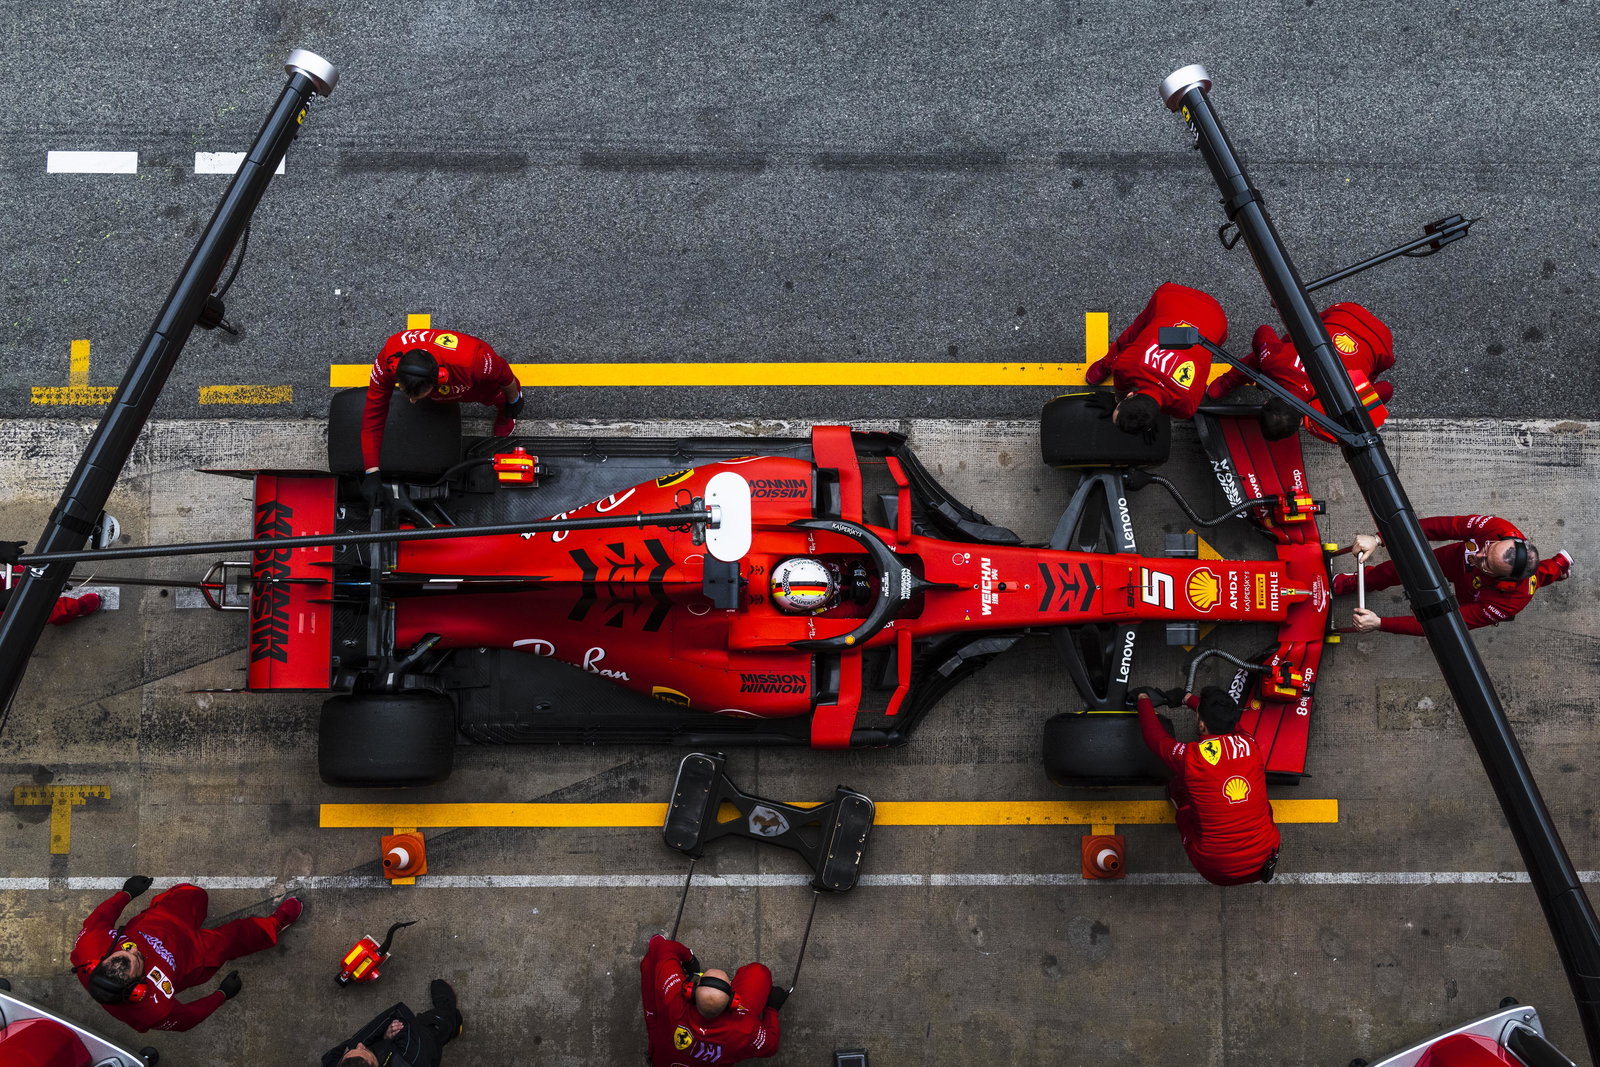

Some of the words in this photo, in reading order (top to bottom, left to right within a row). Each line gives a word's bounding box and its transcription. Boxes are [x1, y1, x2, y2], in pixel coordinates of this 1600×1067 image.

[1118, 497, 1136, 550] Lenovo
[981, 557, 991, 616] WEICHAI
[1140, 566, 1175, 611] 5
[1229, 581, 1238, 610] AMD
[1269, 571, 1279, 611] MAHLE
[1116, 630, 1136, 684] Lenovo
[739, 673, 807, 684] MISSION
[739, 684, 807, 694] WINNOW
